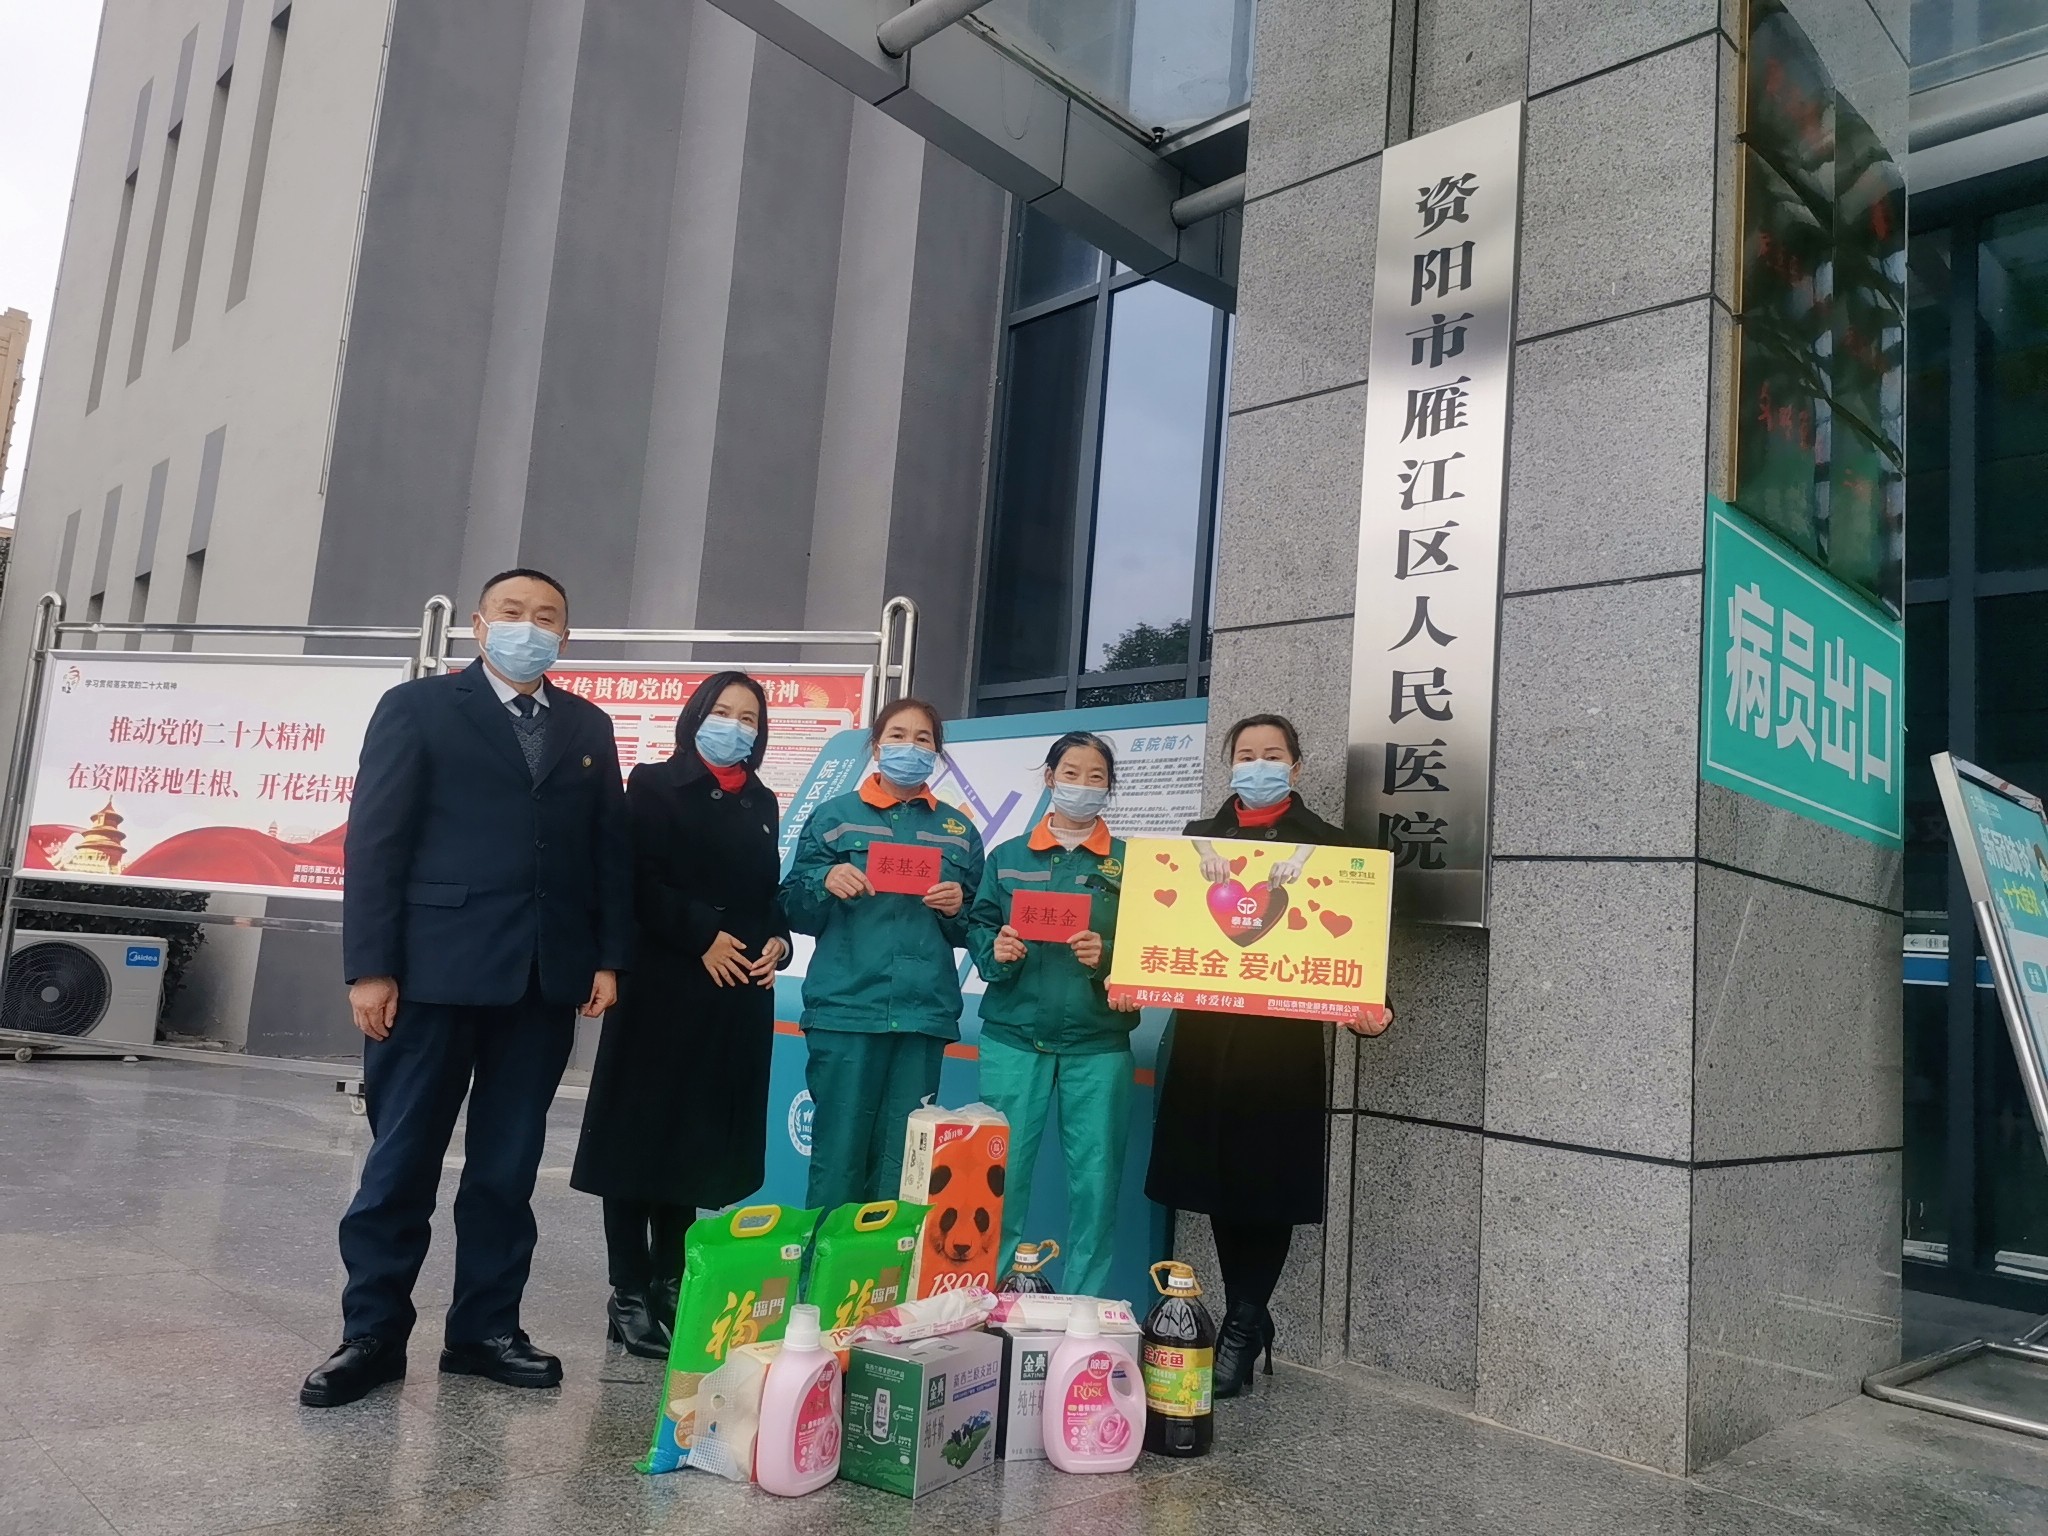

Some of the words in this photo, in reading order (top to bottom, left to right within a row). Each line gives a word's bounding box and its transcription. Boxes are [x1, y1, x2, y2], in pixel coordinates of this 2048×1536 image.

[1377, 172, 1480, 870] 资阳市雁江区人民医院
[85, 679, 178, 690] 学习贯彻落实党的二十大精神
[1725, 582, 1892, 794] 病员出口
[109, 715, 326, 751] 推动党的二十大精神
[1130, 734, 1194, 752] 医院简介
[67, 762, 355, 804] 在资阳落地生根、开花结果
[293, 864, 345, 875] 资阳市雁江区人
[877, 856, 932, 878] 泰基金
[1020, 905, 1077, 927] 泰基金
[1231, 916, 1263, 927] 泰基金
[128, 951, 158, 962] Midea
[1140, 945, 1229, 978] 泰基金
[1239, 952, 1363, 988] 爱心援助
[1136, 990, 1185, 1004] 践行公益
[1195, 993, 1245, 1008] 将爱传递
[1023, 1353, 1046, 1373] 金典
[1144, 1345, 1185, 1368] 金龙鱼
[929, 1376, 945, 1401] 金典
